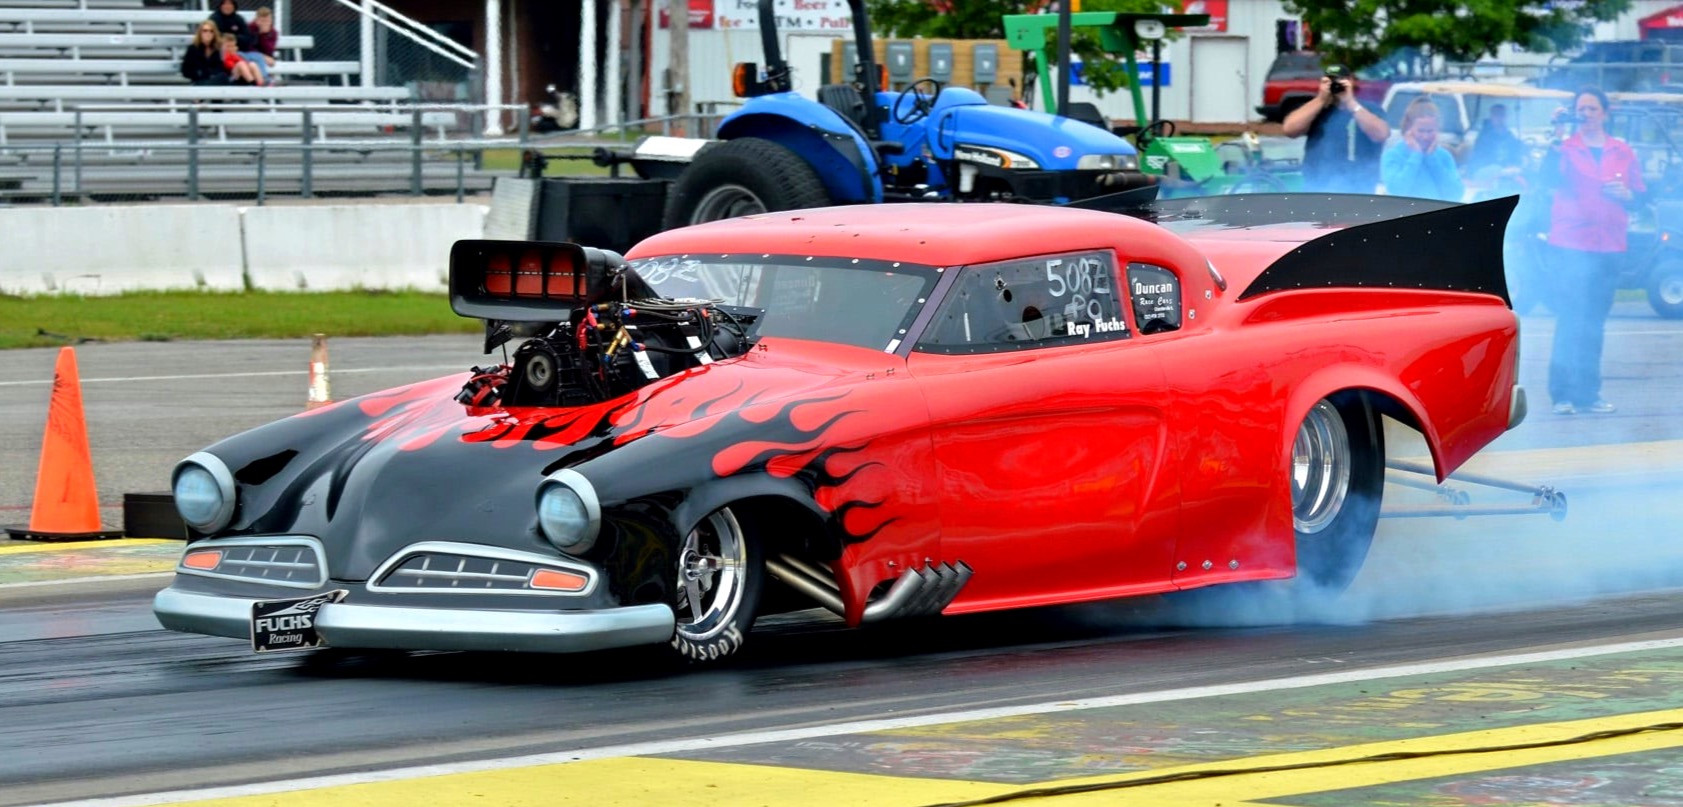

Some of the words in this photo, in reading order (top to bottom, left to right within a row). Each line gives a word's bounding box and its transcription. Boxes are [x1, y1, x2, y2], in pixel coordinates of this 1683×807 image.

[794, 0, 827, 10] Beer
[719, 16, 742, 27] Ice
[775, 16, 801, 28] TM
[1135, 282, 1173, 295] Duncan
[1140, 297, 1154, 306] Race
[1157, 296, 1173, 306] Cars
[1067, 321, 1090, 338] Ray
[1095, 317, 1126, 333] Fuchs
[255, 614, 312, 633] FUCHS
[268, 631, 303, 645] Racing
